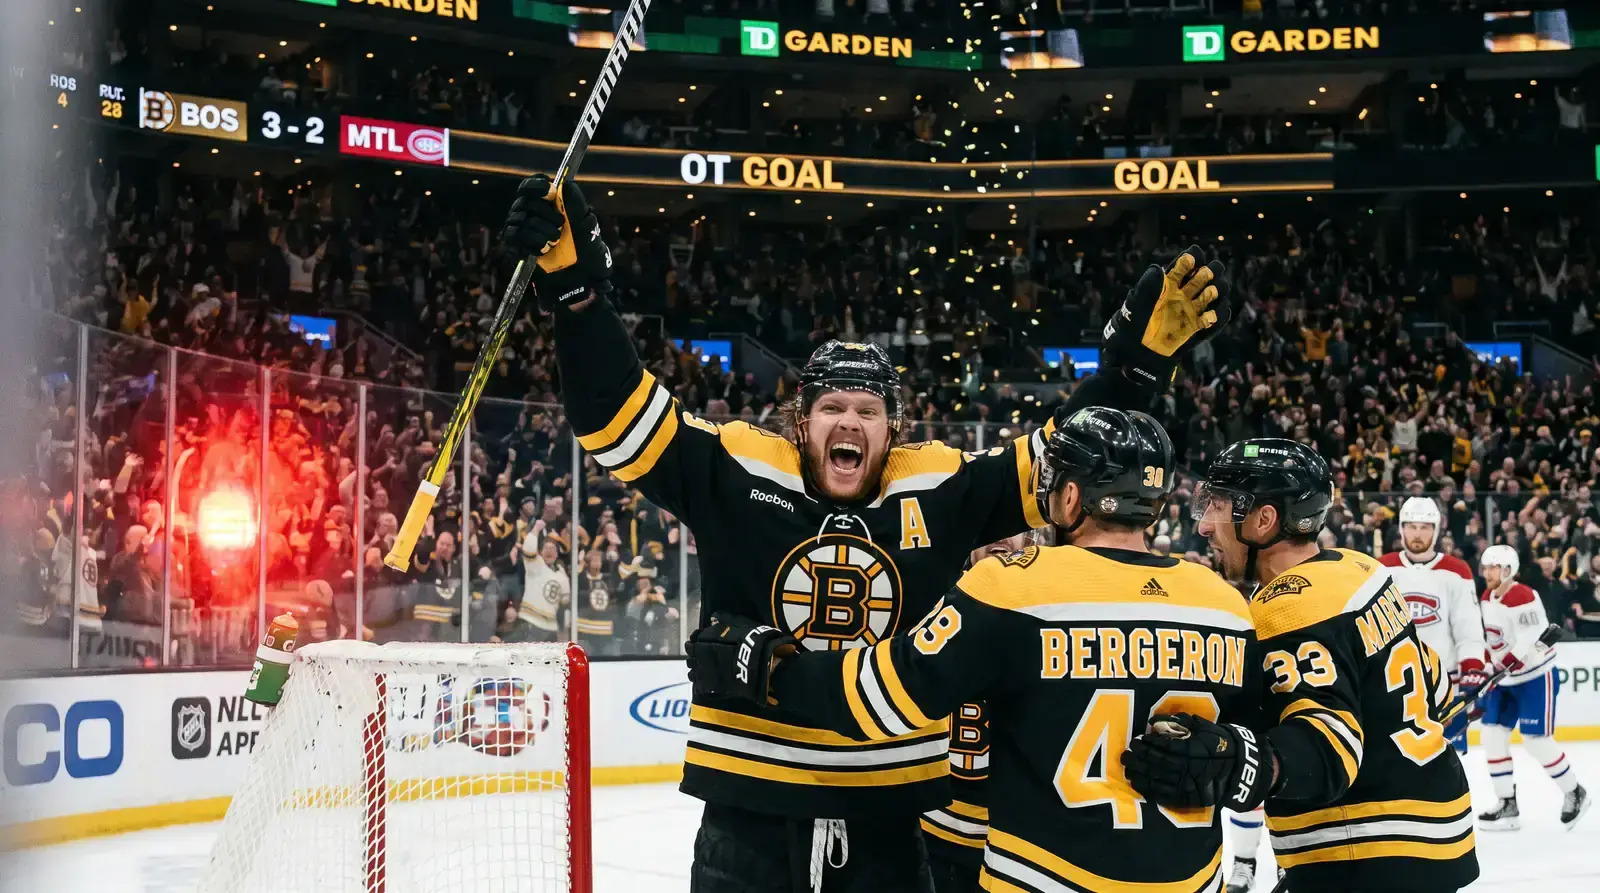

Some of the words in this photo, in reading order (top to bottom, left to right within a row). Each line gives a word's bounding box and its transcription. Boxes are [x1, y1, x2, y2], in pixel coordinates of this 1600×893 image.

[743, 26, 775, 50] TD
[784, 30, 912, 58] GARDEN
[1186, 31, 1220, 55] TD
[1231, 26, 1379, 53] GARDEN
[57, 91, 68, 108] 4
[180, 101, 239, 133] BOS
[262, 111, 281, 139] 3
[305, 116, 324, 144] 2
[347, 123, 404, 153] MTL
[681, 154, 731, 185] OT
[743, 156, 844, 190] GOAL
[1114, 160, 1220, 191] GOAL
[899, 497, 931, 550] A
[1039, 627, 1247, 687] BERGERON
[1262, 640, 1338, 694] 33
[3, 699, 125, 787] CO
